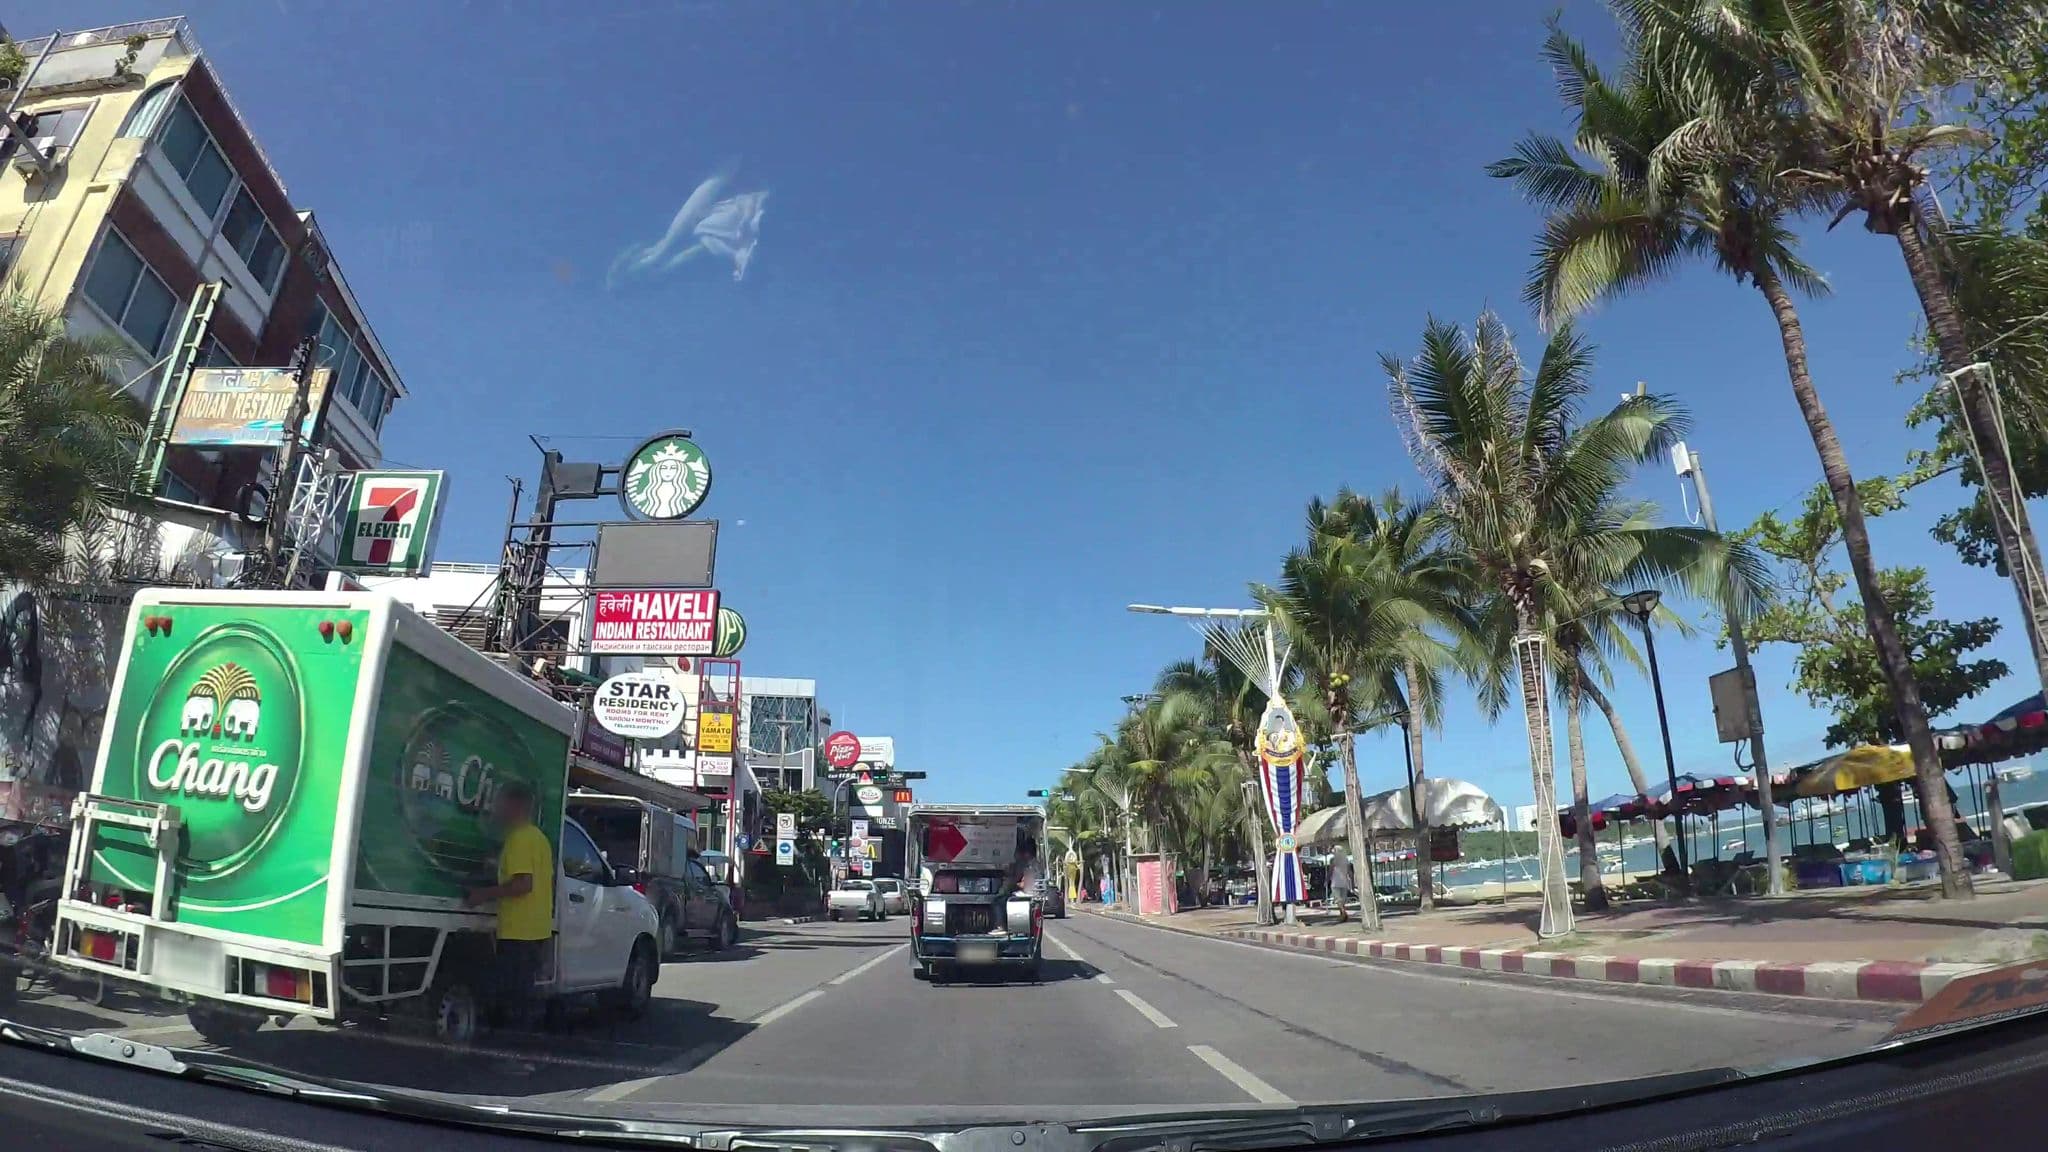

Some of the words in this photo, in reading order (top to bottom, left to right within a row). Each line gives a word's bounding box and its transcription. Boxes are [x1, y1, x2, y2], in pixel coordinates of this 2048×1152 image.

[183, 391, 230, 419] INDIAN
[232, 392, 323, 420] RESTAURT
[632, 593, 714, 619] HAVELI
[595, 621, 633, 640] INDIAN
[635, 622, 711, 640] RESTAURANT
[610, 682, 670, 700] STAR
[599, 697, 679, 711] RESIDENCY
[148, 738, 279, 813] Chang
